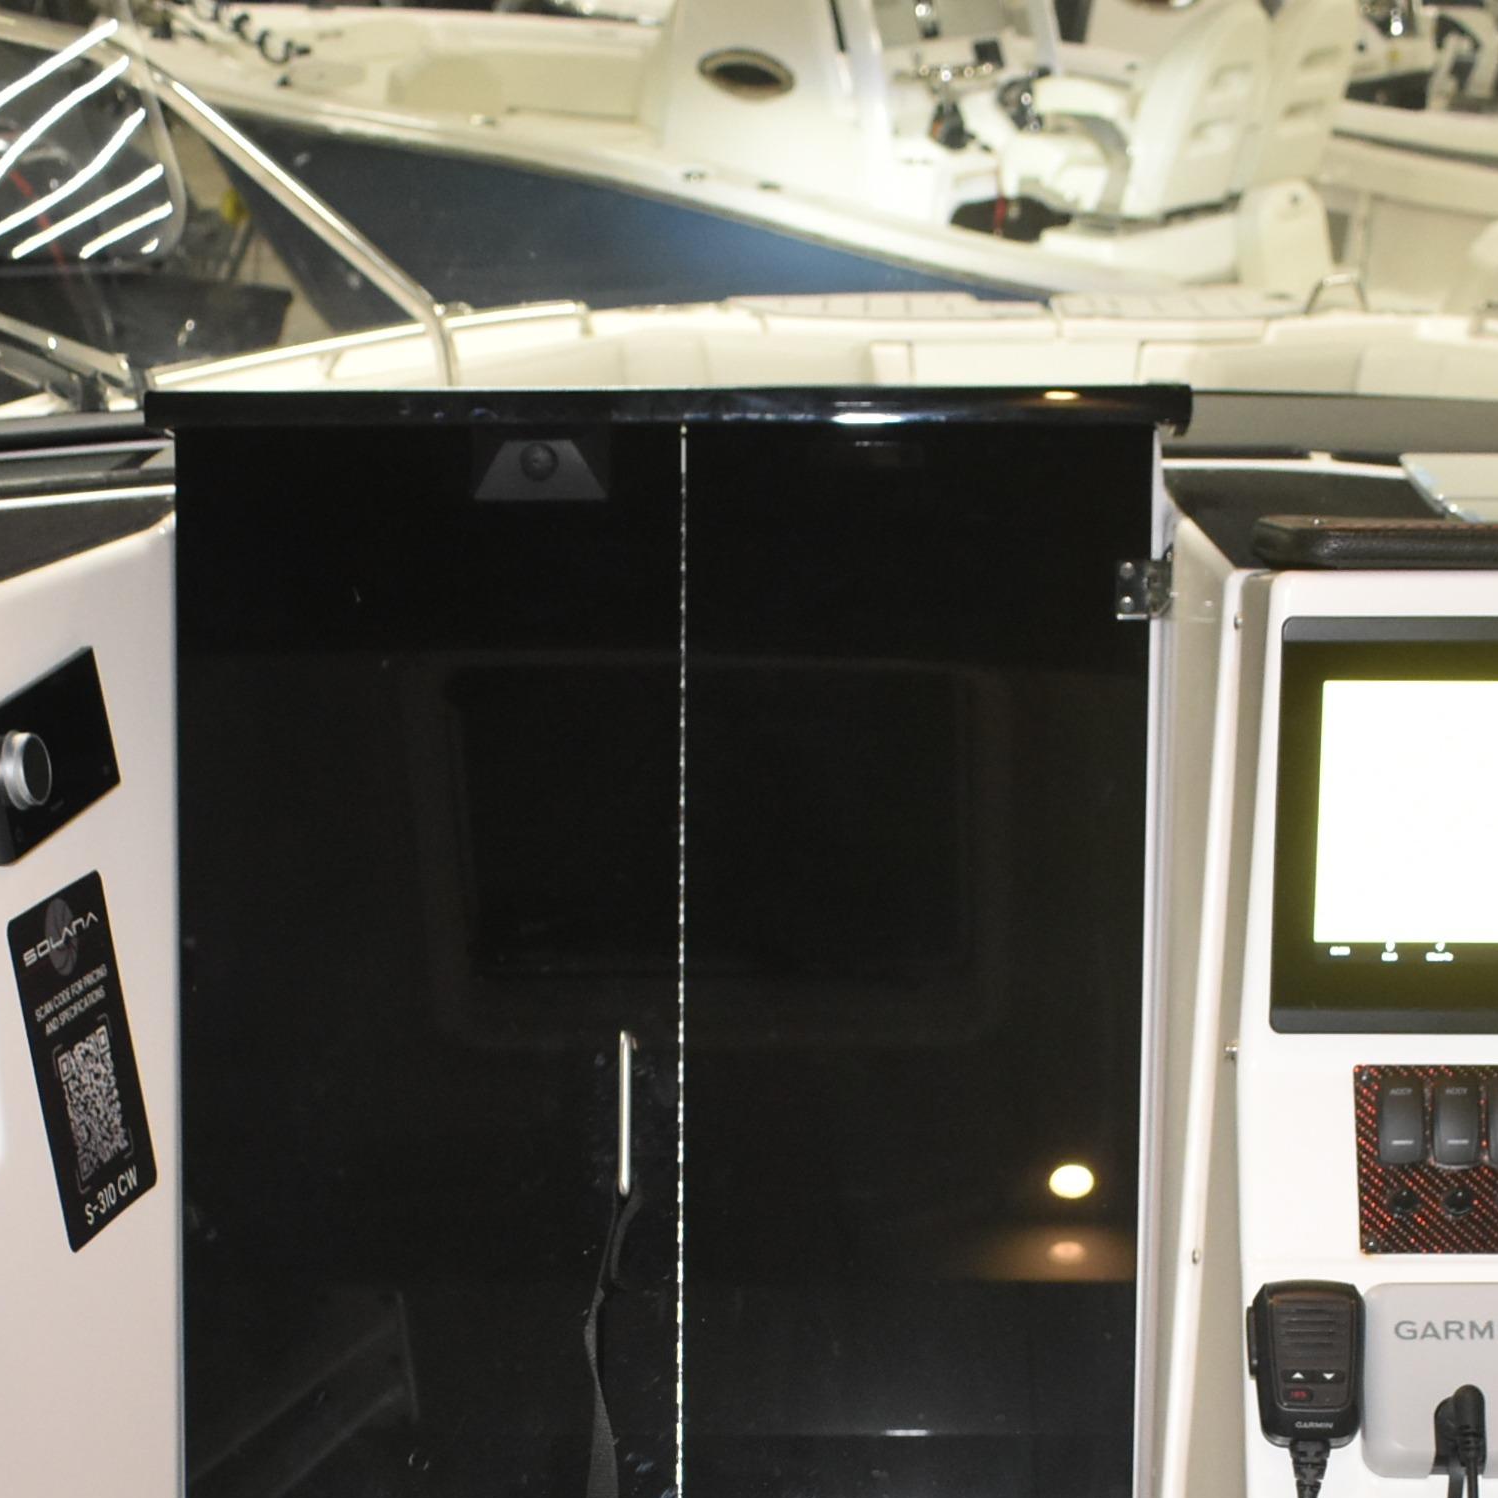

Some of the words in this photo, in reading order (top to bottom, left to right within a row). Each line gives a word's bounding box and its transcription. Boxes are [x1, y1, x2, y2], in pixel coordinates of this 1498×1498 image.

[23, 911, 99, 968] SOLANA
[70, 979, 84, 997] FOR
[45, 1015, 60, 1037] AND
[84, 1182, 118, 1226] S-310
[117, 1164, 138, 1197] CW
[1294, 1420, 1334, 1429] GARMIN
